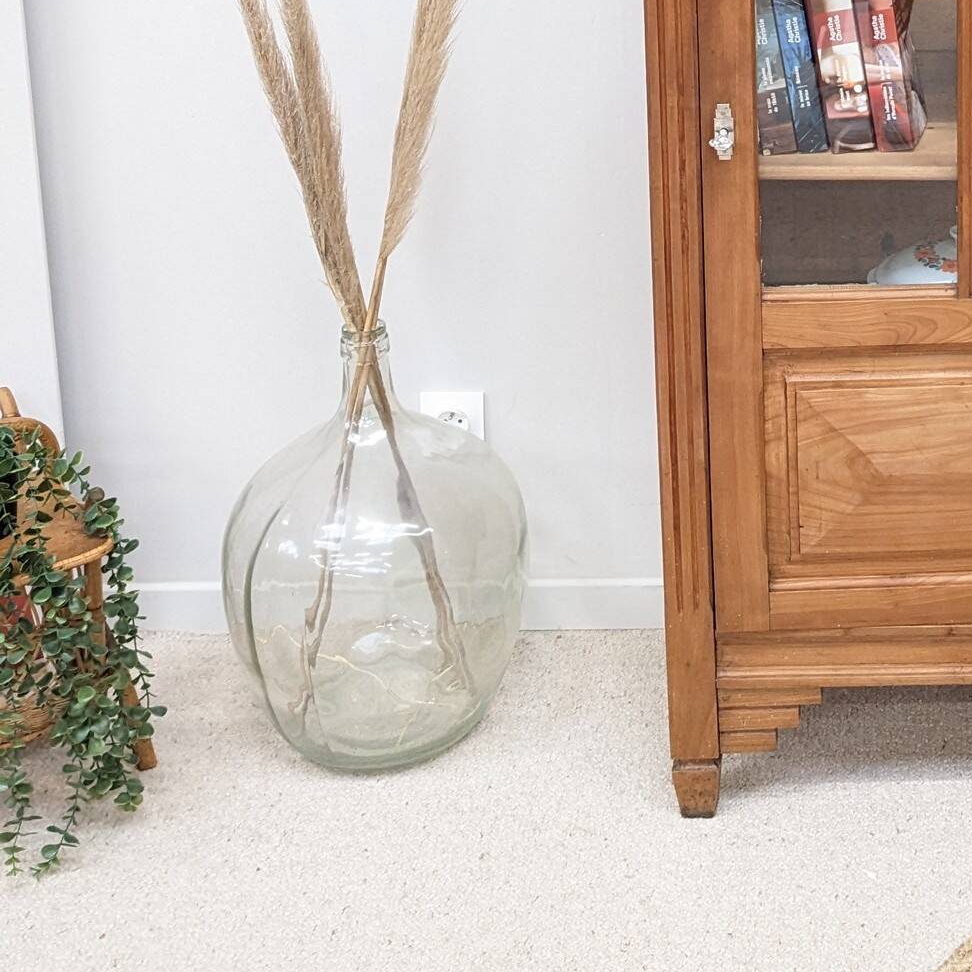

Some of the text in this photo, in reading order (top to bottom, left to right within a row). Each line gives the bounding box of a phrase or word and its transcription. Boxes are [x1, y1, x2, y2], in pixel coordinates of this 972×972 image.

[759, 18, 768, 45] Christie
[785, 19, 795, 43] Agatha
[792, 16, 801, 43] Christie
[827, 17, 836, 41] Agatha
[833, 14, 843, 41] Christie
[871, 15, 880, 40] Agatha
[878, 13, 887, 40] Christie
